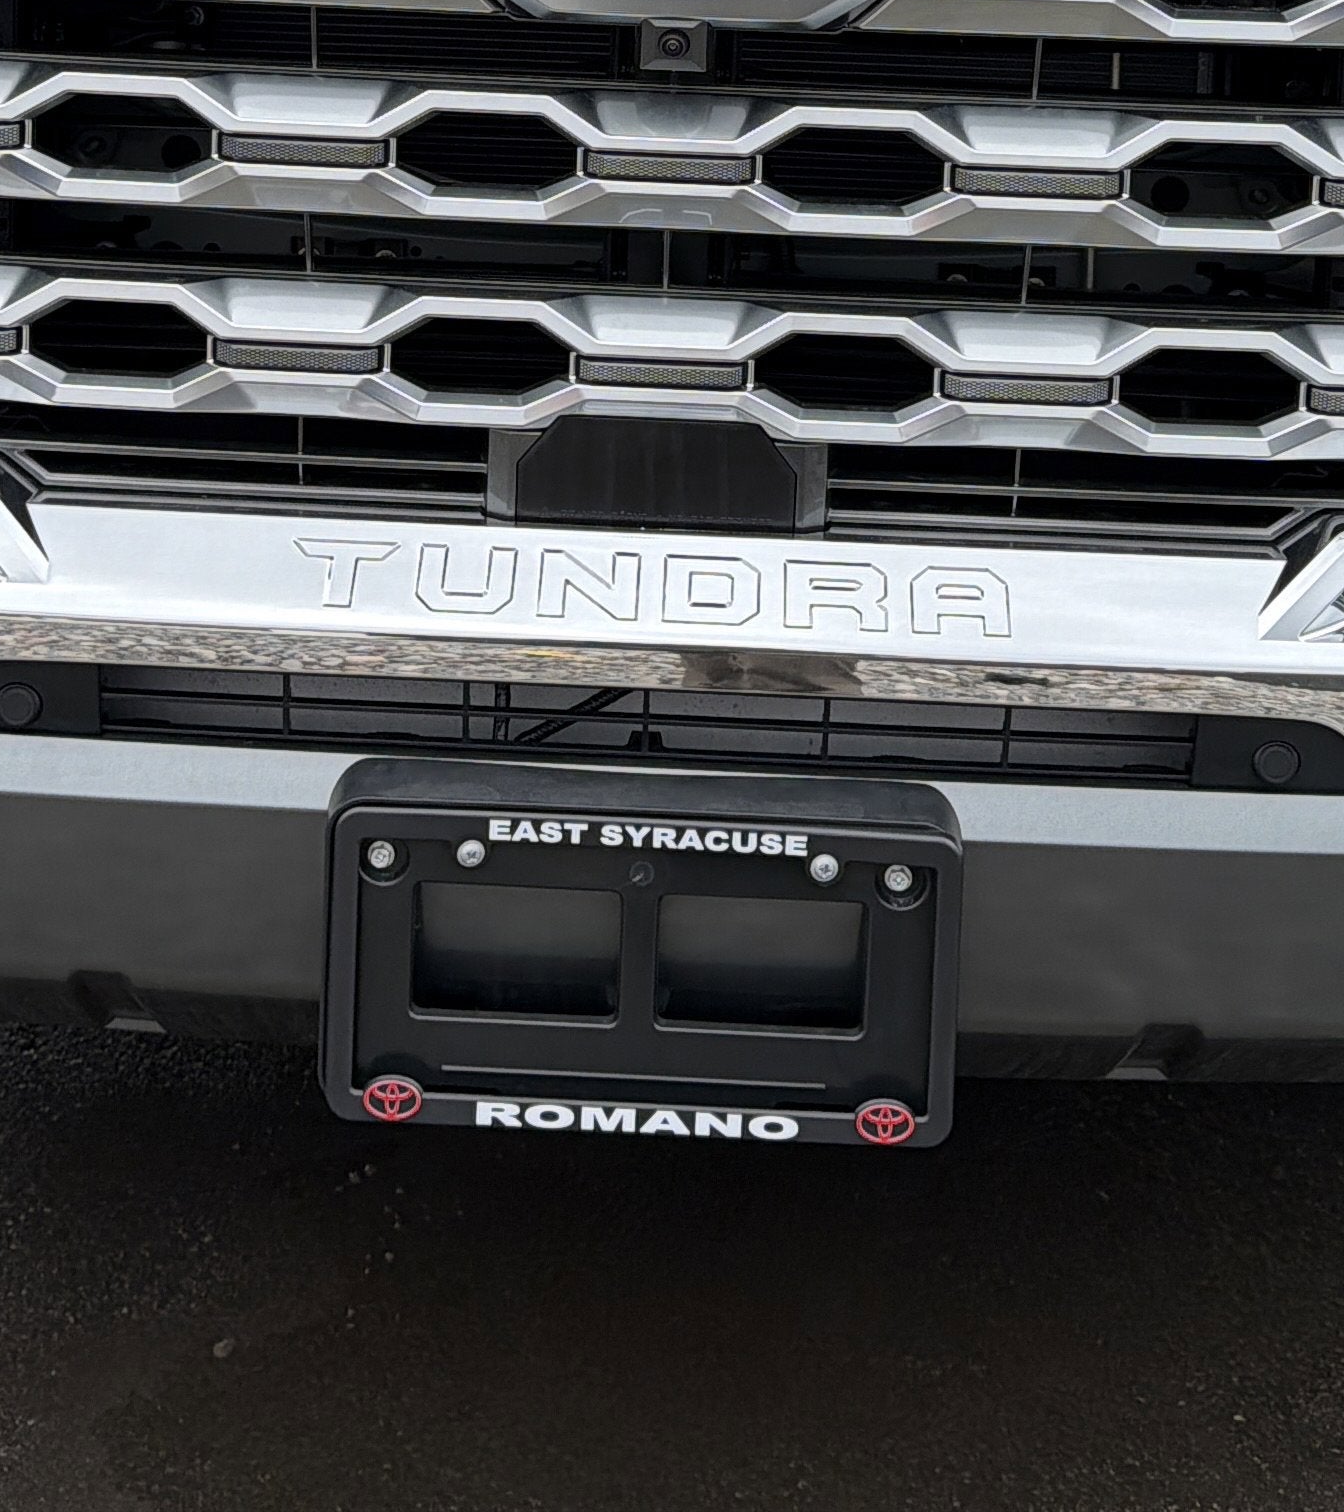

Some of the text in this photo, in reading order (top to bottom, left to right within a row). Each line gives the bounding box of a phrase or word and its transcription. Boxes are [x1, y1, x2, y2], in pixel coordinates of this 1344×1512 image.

[291, 537, 1013, 638] TUNDRA
[488, 819, 809, 857] EAST SYRACUSE
[475, 1101, 800, 1141] ROMANO
